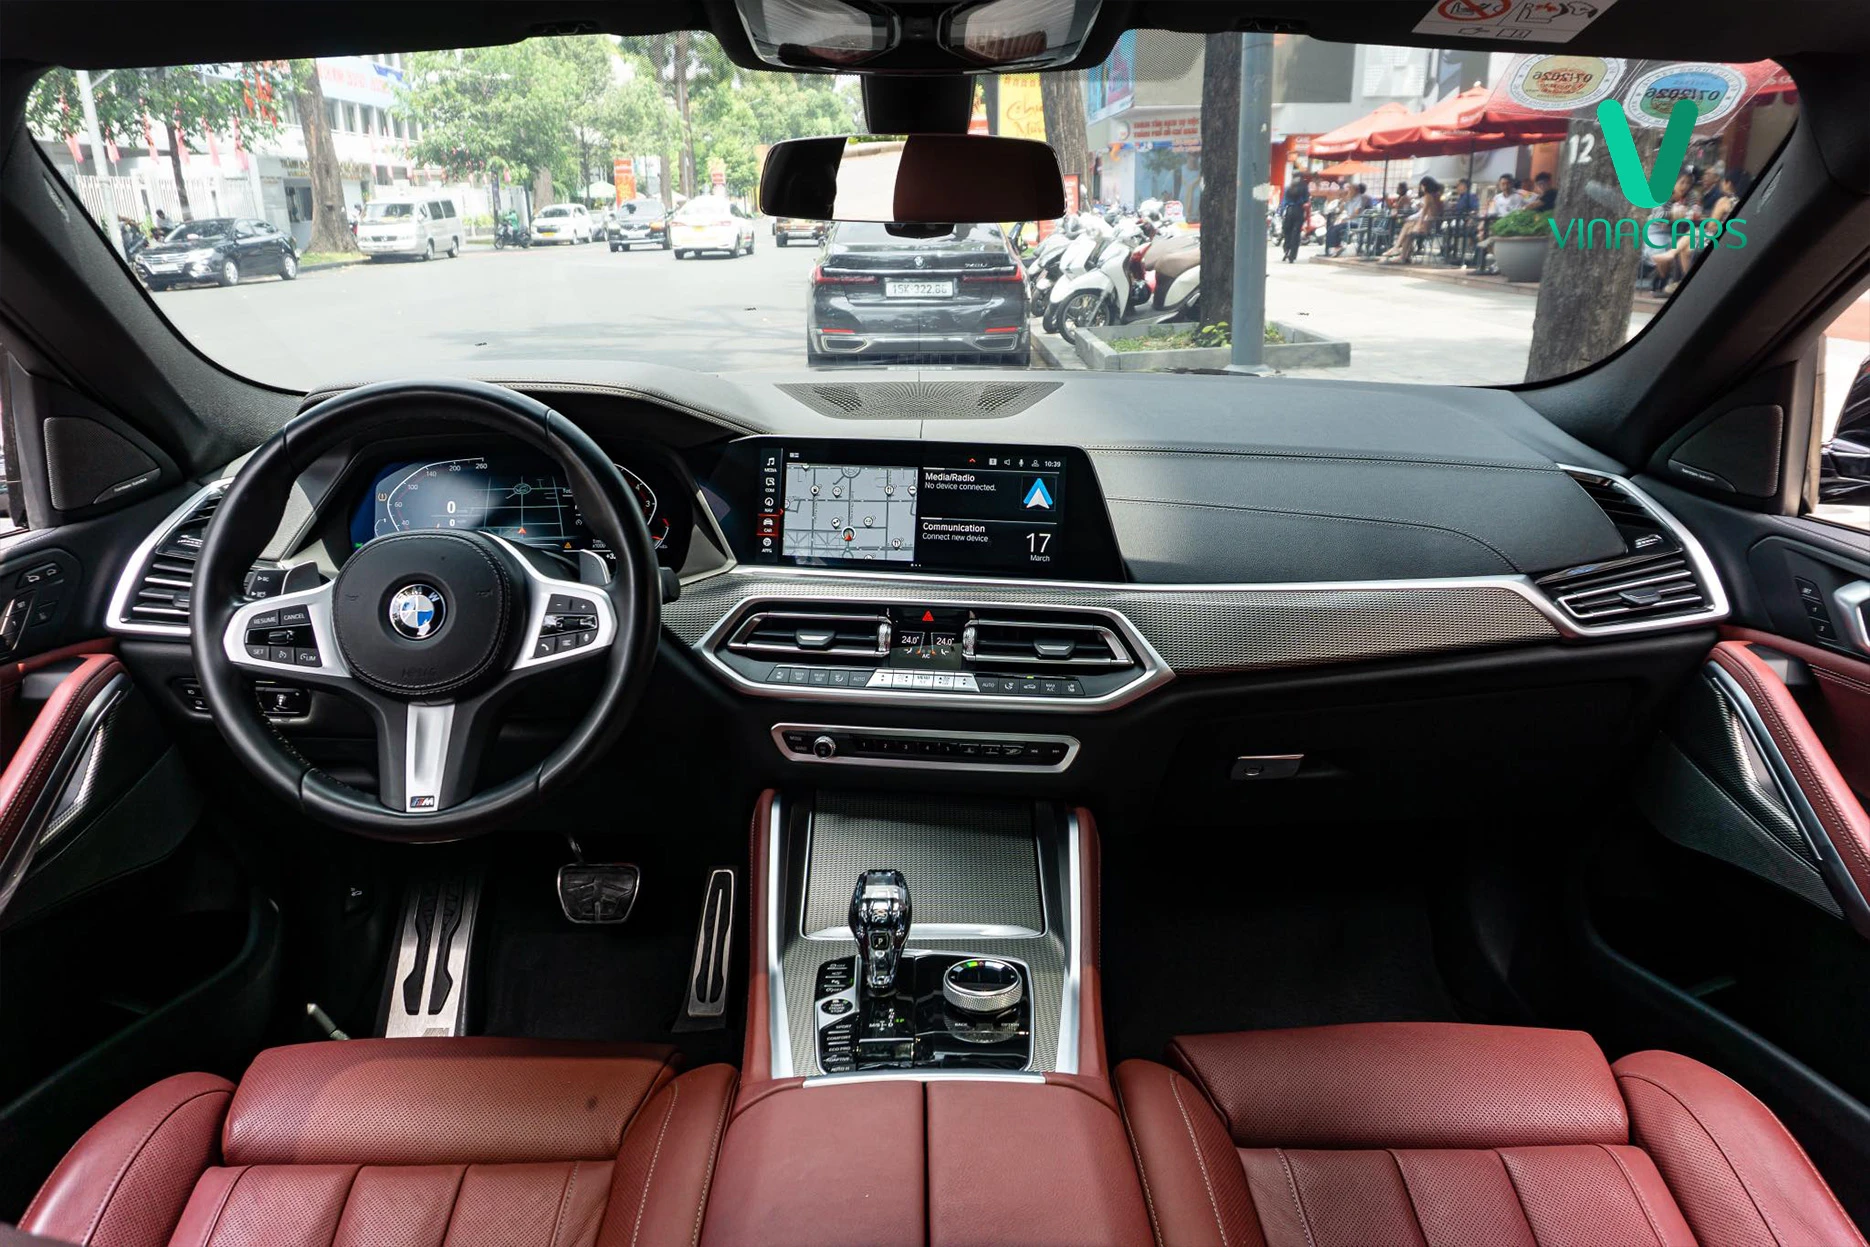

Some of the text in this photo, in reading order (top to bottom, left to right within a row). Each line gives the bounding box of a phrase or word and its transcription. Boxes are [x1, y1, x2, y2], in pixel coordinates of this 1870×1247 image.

[1569, 133, 1595, 164] 12
[925, 472, 975, 482] Media/Radio
[936, 482, 958, 490] device
[959, 483, 996, 491] connected.
[446, 500, 456, 514] 0
[645, 500, 650, 508] 3
[449, 519, 455, 527] 0
[922, 522, 985, 533] Communication
[922, 533, 950, 541] Connect
[966, 534, 988, 542] device
[1026, 532, 1051, 553] 17
[1030, 554, 1050, 562] March
[253, 616, 276, 625] RESUME
[283, 613, 305, 621] CANCEL
